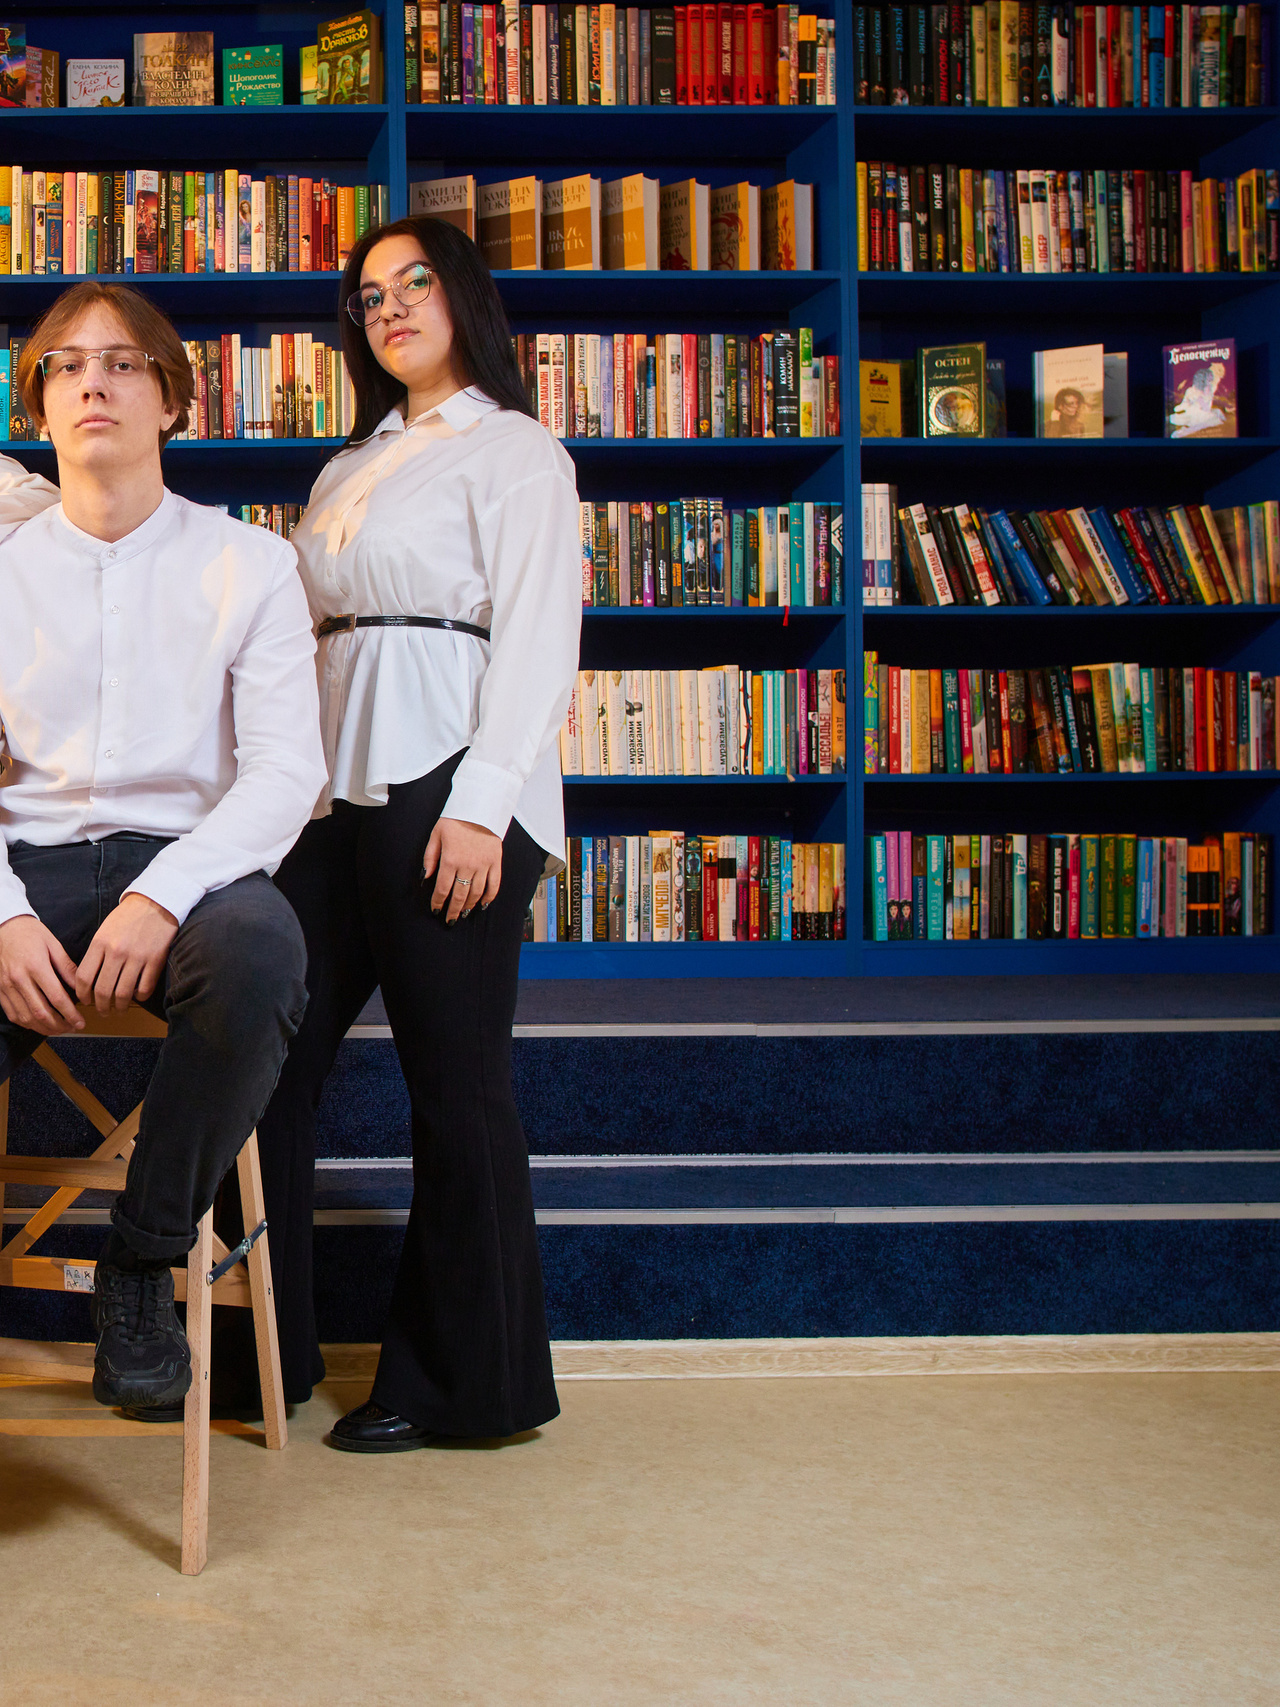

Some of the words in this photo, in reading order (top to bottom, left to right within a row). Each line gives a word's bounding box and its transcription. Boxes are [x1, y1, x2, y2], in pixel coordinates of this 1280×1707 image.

[721, 22, 731, 51] ЛОНДОН
[141, 52, 208, 67] ТОЛКИН
[507, 48, 518, 68] ЛИСС
[721, 53, 731, 76] ДЖЕК
[939, 39, 948, 102] НОВОЛУНИЕ
[230, 74, 277, 83] Шопоголик
[236, 82, 281, 91] Рождество
[507, 70, 518, 95] ДЭВИД
[114, 175, 124, 201] КУНЦ
[114, 206, 124, 224] ДИН
[0, 230, 8, 265] КАССЛЕР
[616, 344, 624, 390] МИСИМА
[778, 357, 786, 384] КОЛИН
[786, 350, 794, 391] МАККАЛОУ
[935, 356, 971, 367] ОСТЕН
[553, 368, 563, 400] МАКЛИН
[938, 577, 949, 597] РОЗА
[628, 721, 636, 765] мураками
[635, 721, 644, 765] мураками
[717, 722, 726, 765] мураками
[820, 716, 832, 767] МЕССАДЬЕ
[596, 864, 606, 883] ЕСЛИ
[596, 884, 606, 914] АНГЕЛЫ
[655, 883, 670, 928] МИТЧЕЛЛ
[596, 915, 607, 938] ПАДУТ
